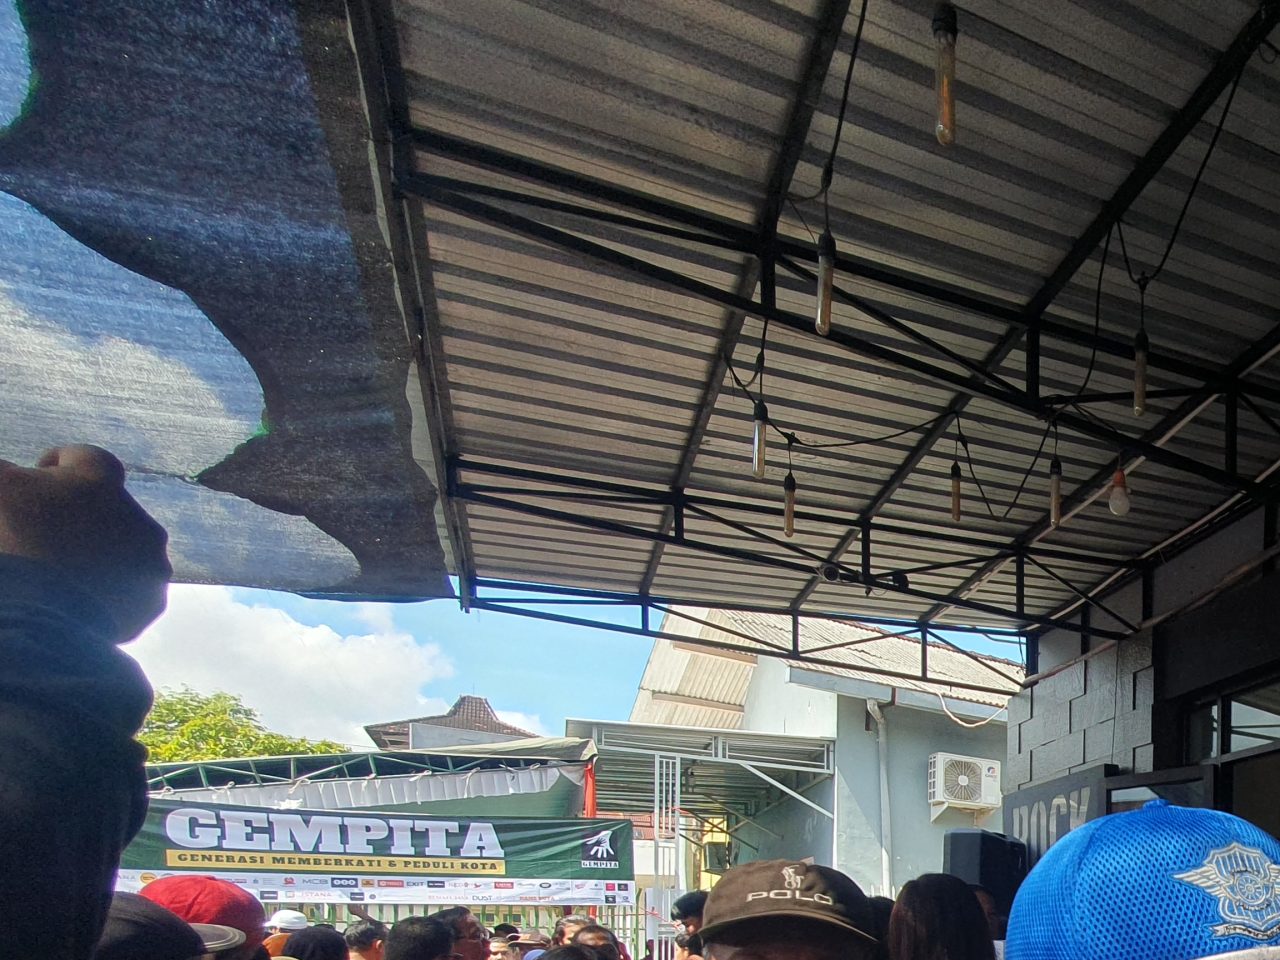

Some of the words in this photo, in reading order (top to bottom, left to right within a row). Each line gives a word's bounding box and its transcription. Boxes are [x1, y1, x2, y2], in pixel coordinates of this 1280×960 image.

[165, 808, 505, 858] GEMPITA
[177, 853, 265, 864] GENERASI
[271, 855, 383, 868] MEMBERKATI
[387, 859, 398, 868] &
[403, 860, 455, 869] PEDULI
[460, 861, 498, 870] KOTA
[746, 889, 833, 906] POLO
